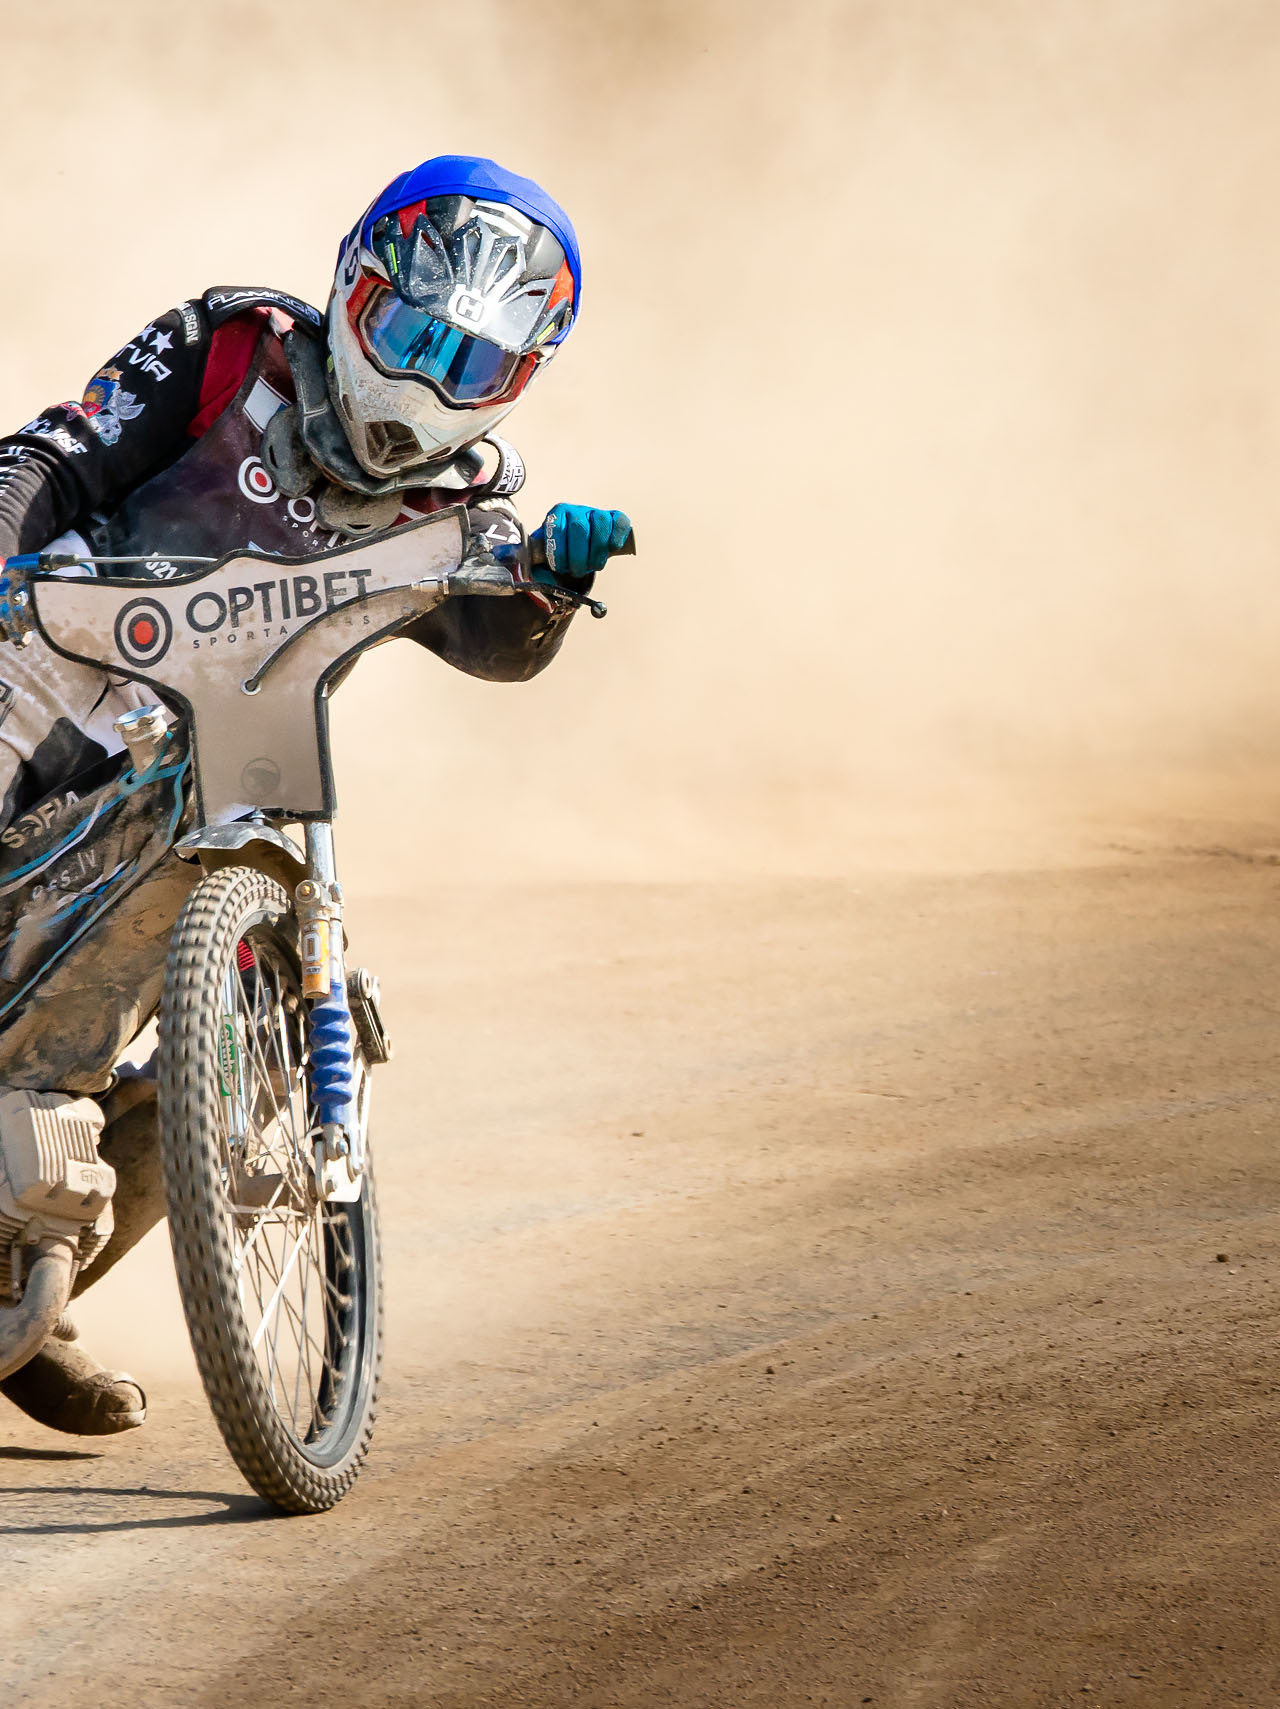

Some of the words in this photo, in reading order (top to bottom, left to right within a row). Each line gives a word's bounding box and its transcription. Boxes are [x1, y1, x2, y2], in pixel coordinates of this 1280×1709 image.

[115, 343, 173, 382] TVIA
[186, 569, 371, 633] OPTIBET
[193, 625, 288, 648] SPORTA
